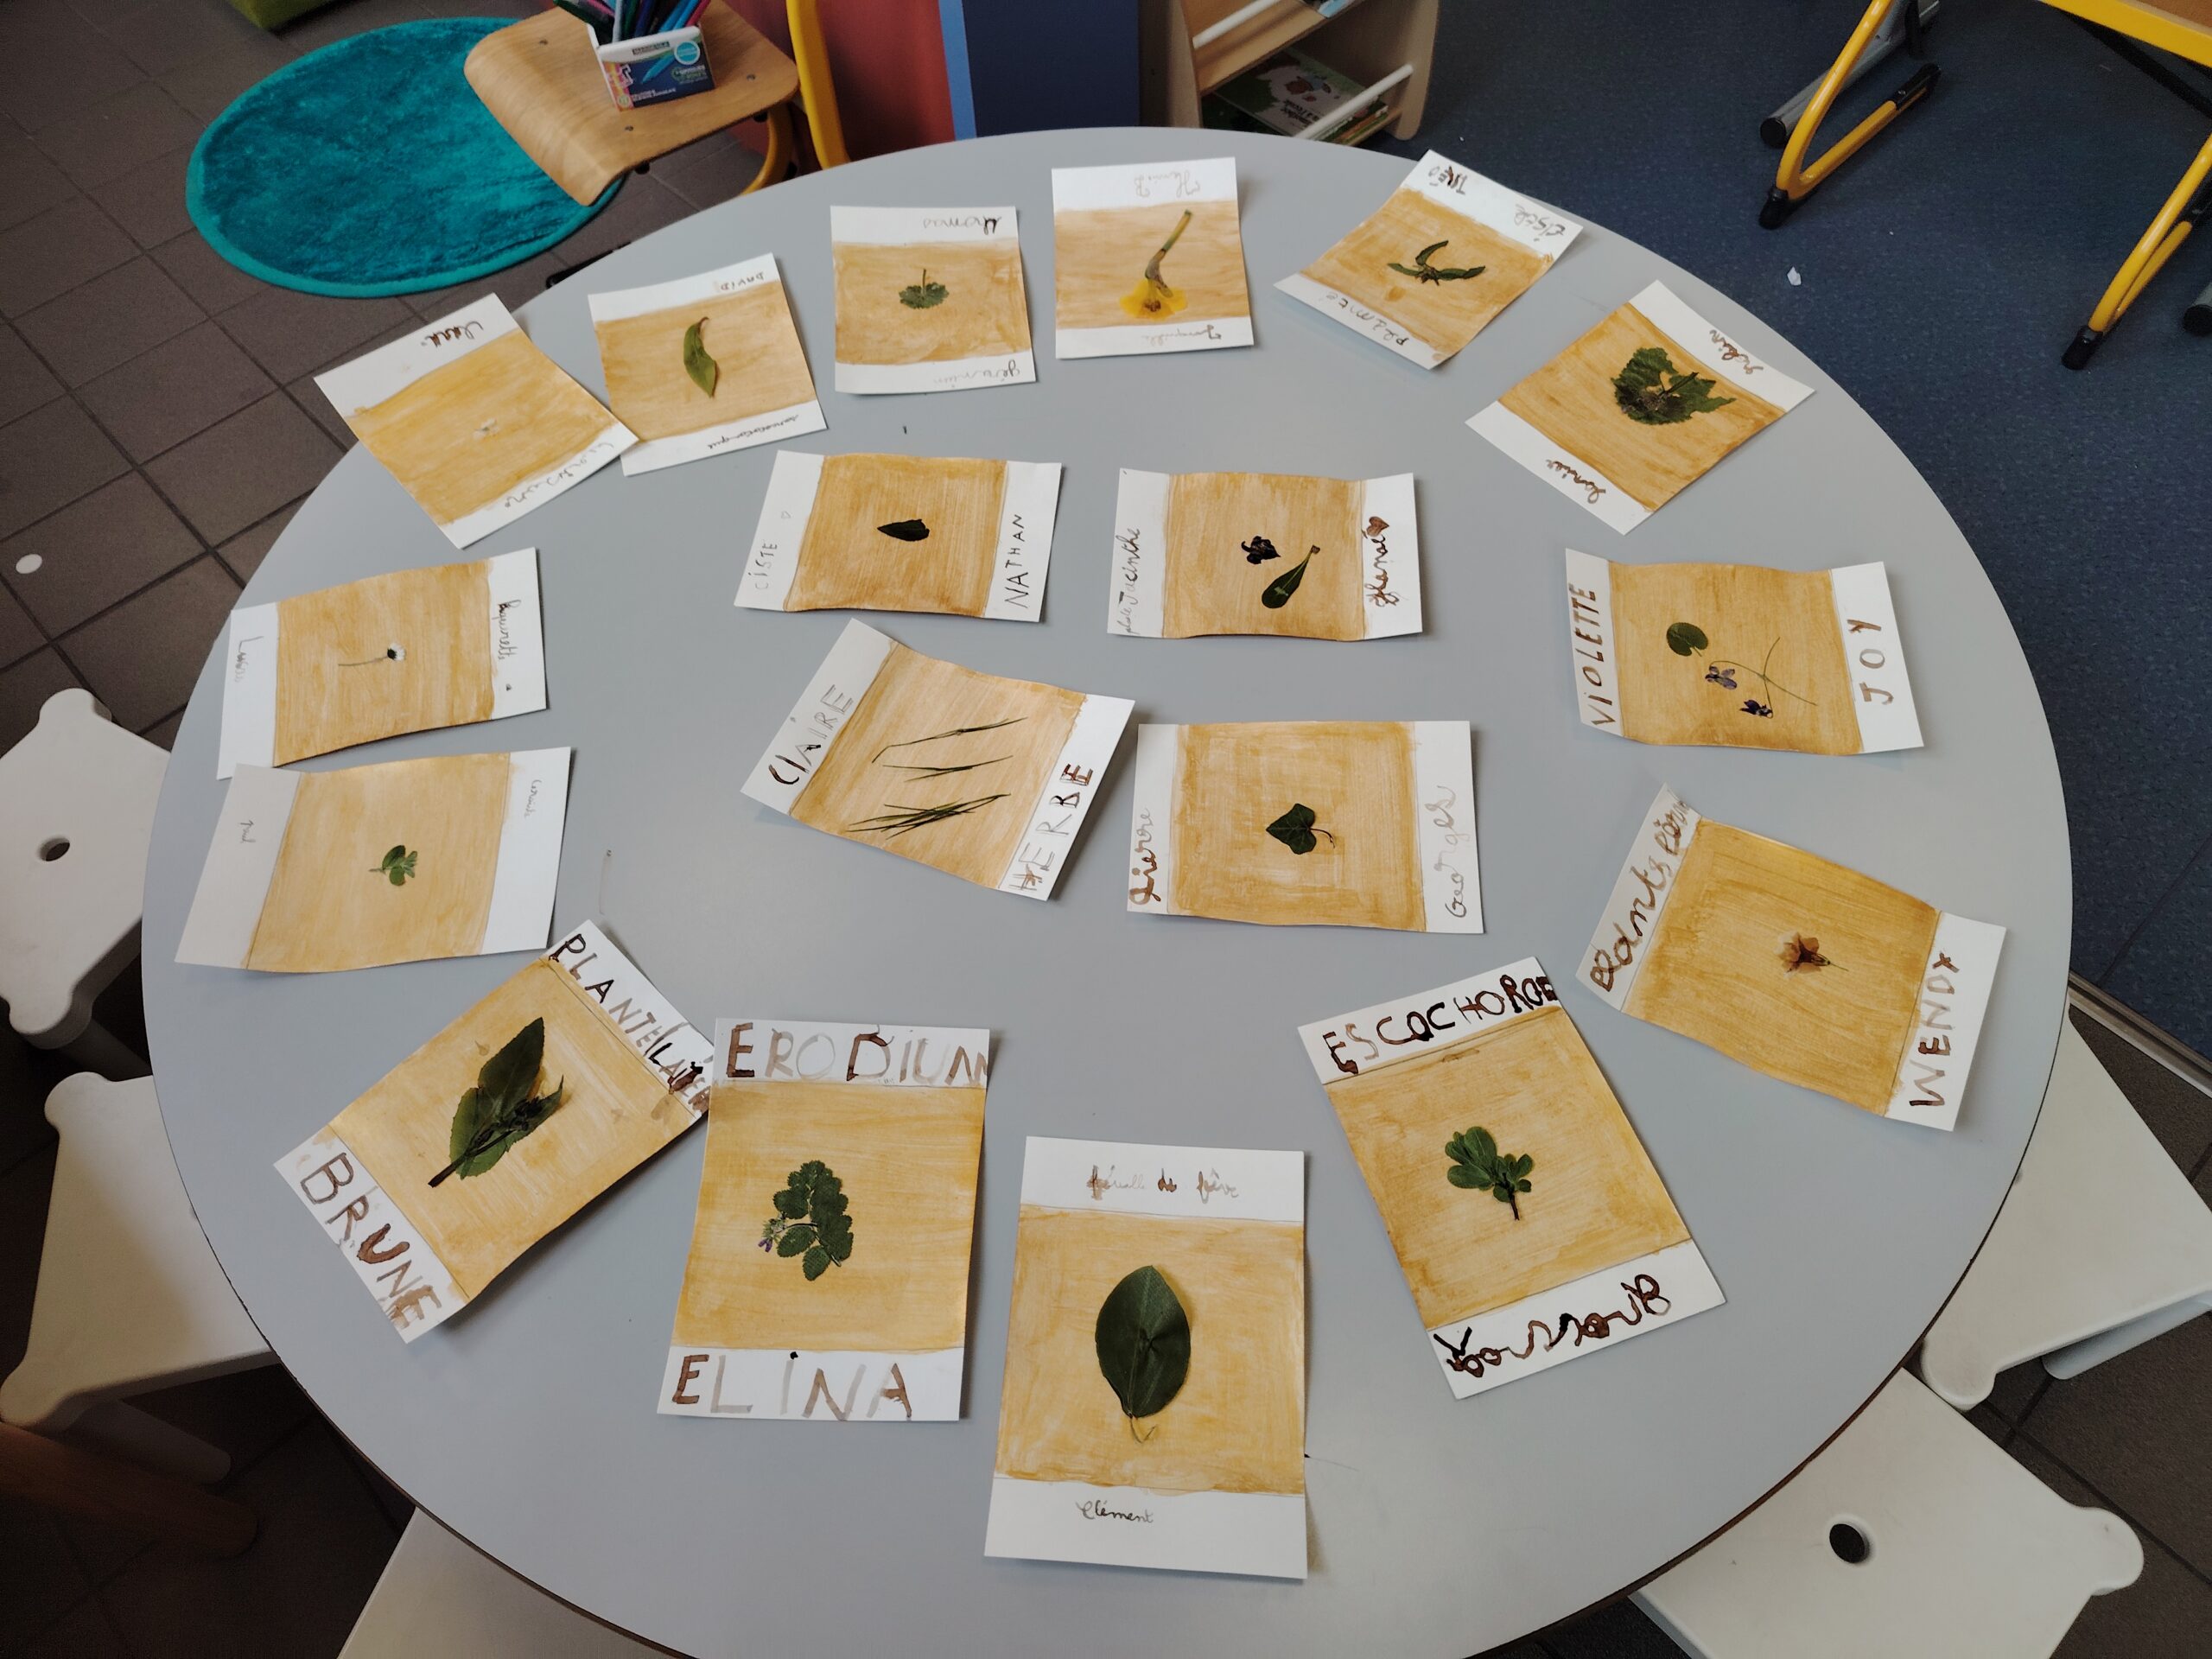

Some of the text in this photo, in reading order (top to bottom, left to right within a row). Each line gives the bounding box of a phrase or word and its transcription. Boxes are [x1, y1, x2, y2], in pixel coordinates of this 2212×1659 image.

[1004, 514, 1030, 609] NATHAN
[1848, 620, 1894, 703] JOY
[1010, 764, 1093, 893] HERBE
[727, 1021, 989, 1083] ERODIUM
[1909, 952, 1959, 1107] WENDY
[302, 1154, 442, 1331] BRUNE
